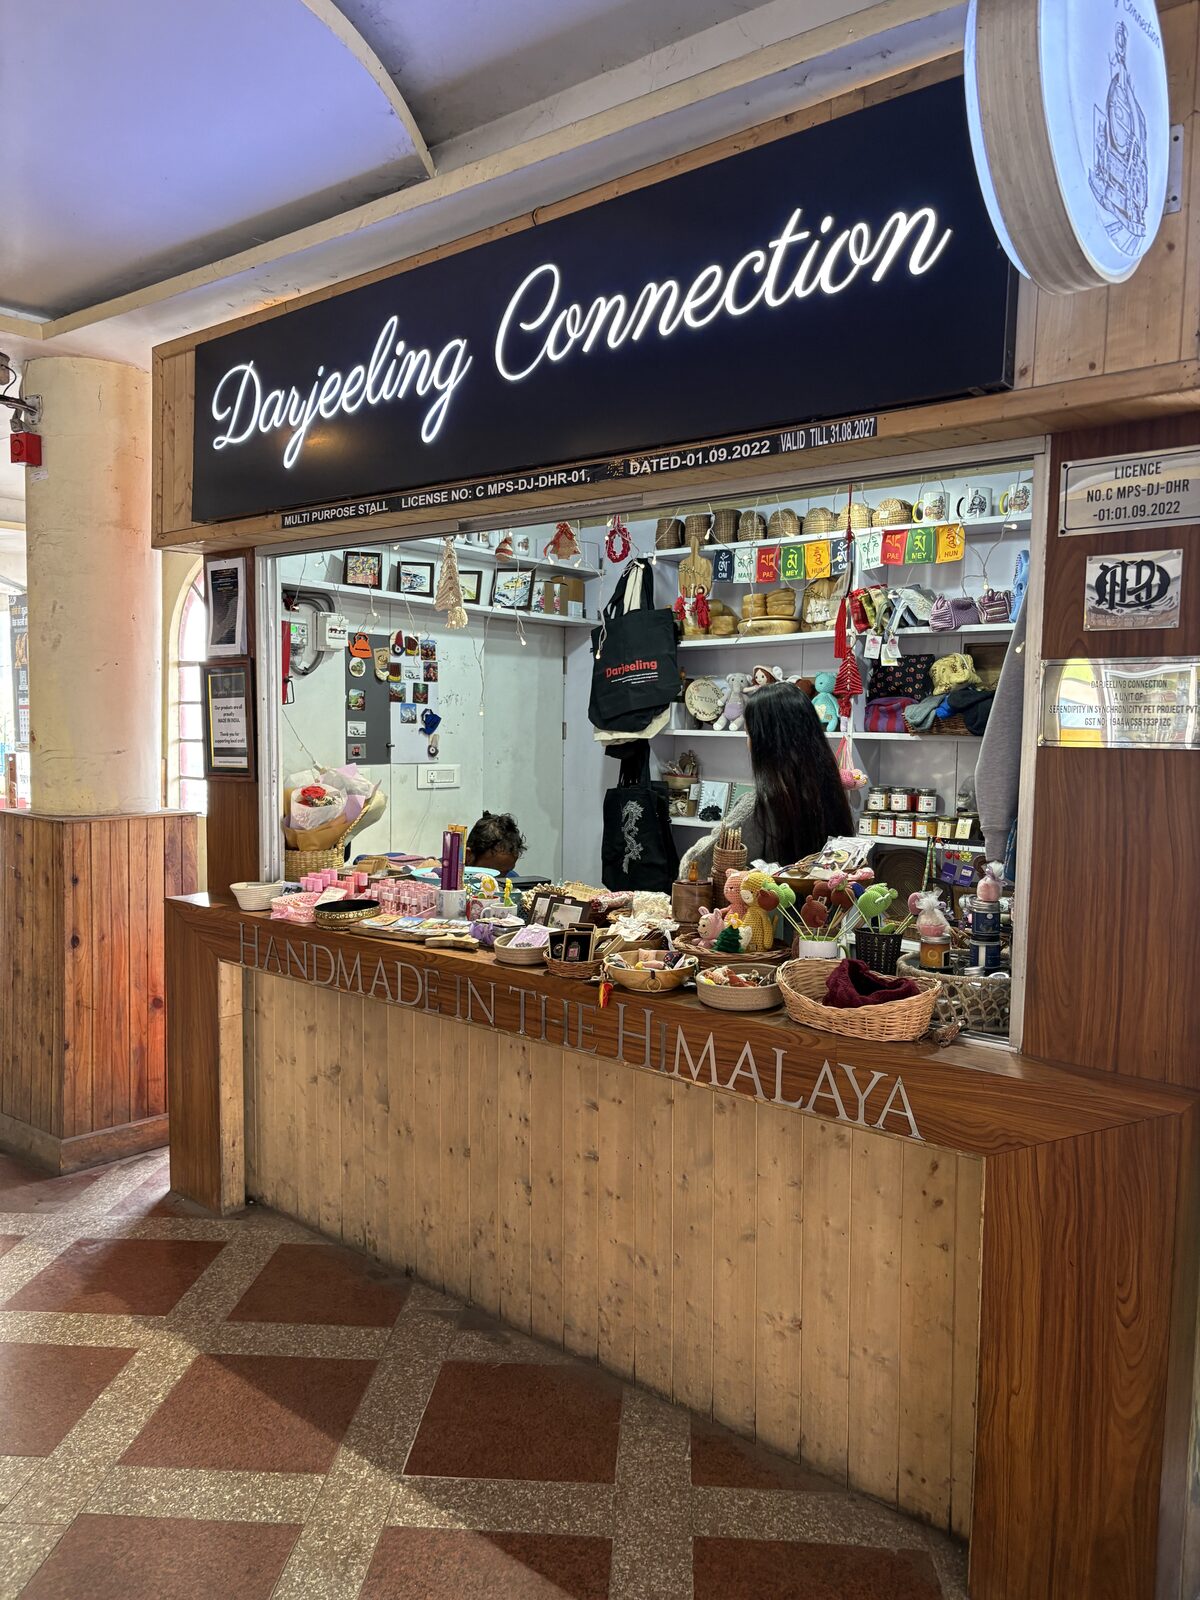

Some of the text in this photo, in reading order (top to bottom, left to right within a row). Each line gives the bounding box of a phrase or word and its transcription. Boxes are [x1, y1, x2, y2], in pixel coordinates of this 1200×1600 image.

[211, 205, 953, 470] Darjeeling Connection
[283, 514, 311, 527] MULTI
[311, 505, 357, 523] PURPOSE
[357, 500, 389, 516] STALL
[401, 491, 449, 509] LICENSE
[451, 488, 473, 502] NO:
[475, 486, 485, 498] C
[780, 429, 806, 452] VALID
[809, 425, 829, 446] TILL
[830, 417, 875, 444] 31.08.2027
[1114, 461, 1162, 480] LICENCE
[1116, 479, 1190, 499] MPS-DJ-DHR
[785, 569, 799, 577] MEY
[606, 659, 658, 678] Darjeeling
[1127, 679, 1168, 689] CONNECTION
[1119, 692, 1134, 701] UNIT
[1135, 692, 1144, 701] OF
[1048, 704, 1086, 714] SERENDIPITY
[1094, 704, 1142, 714] SYNCHRONICITY
[1143, 704, 1156, 714] PET
[1156, 704, 1184, 714] PROJECT
[1084, 717, 1096, 727] GST
[238, 921, 927, 1141] HANDMADE IN THE HIMALAYA
